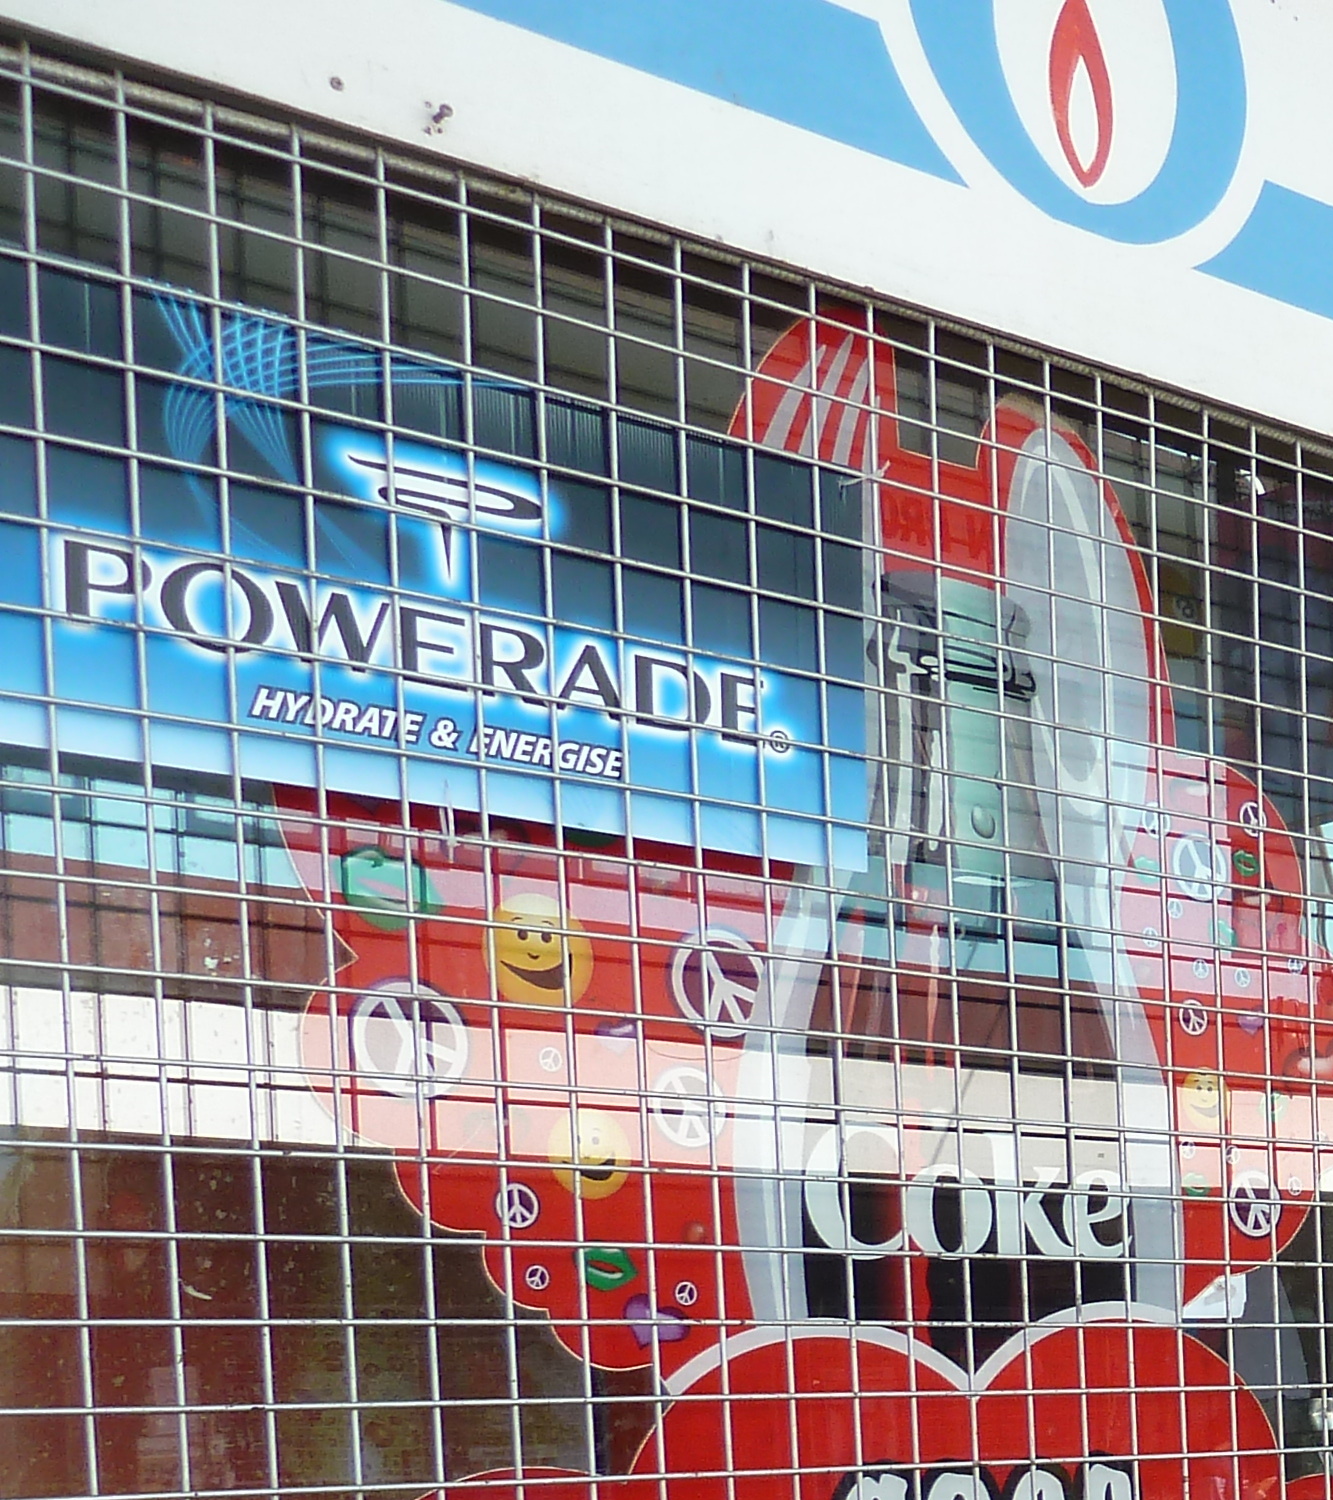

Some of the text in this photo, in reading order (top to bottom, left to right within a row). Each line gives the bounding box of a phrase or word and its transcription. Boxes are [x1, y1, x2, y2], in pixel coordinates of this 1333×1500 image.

[62, 538, 767, 749] POWERADE
[251, 686, 626, 780] HYDRATE & ENERGISE
[804, 1123, 1132, 1262] Coke
